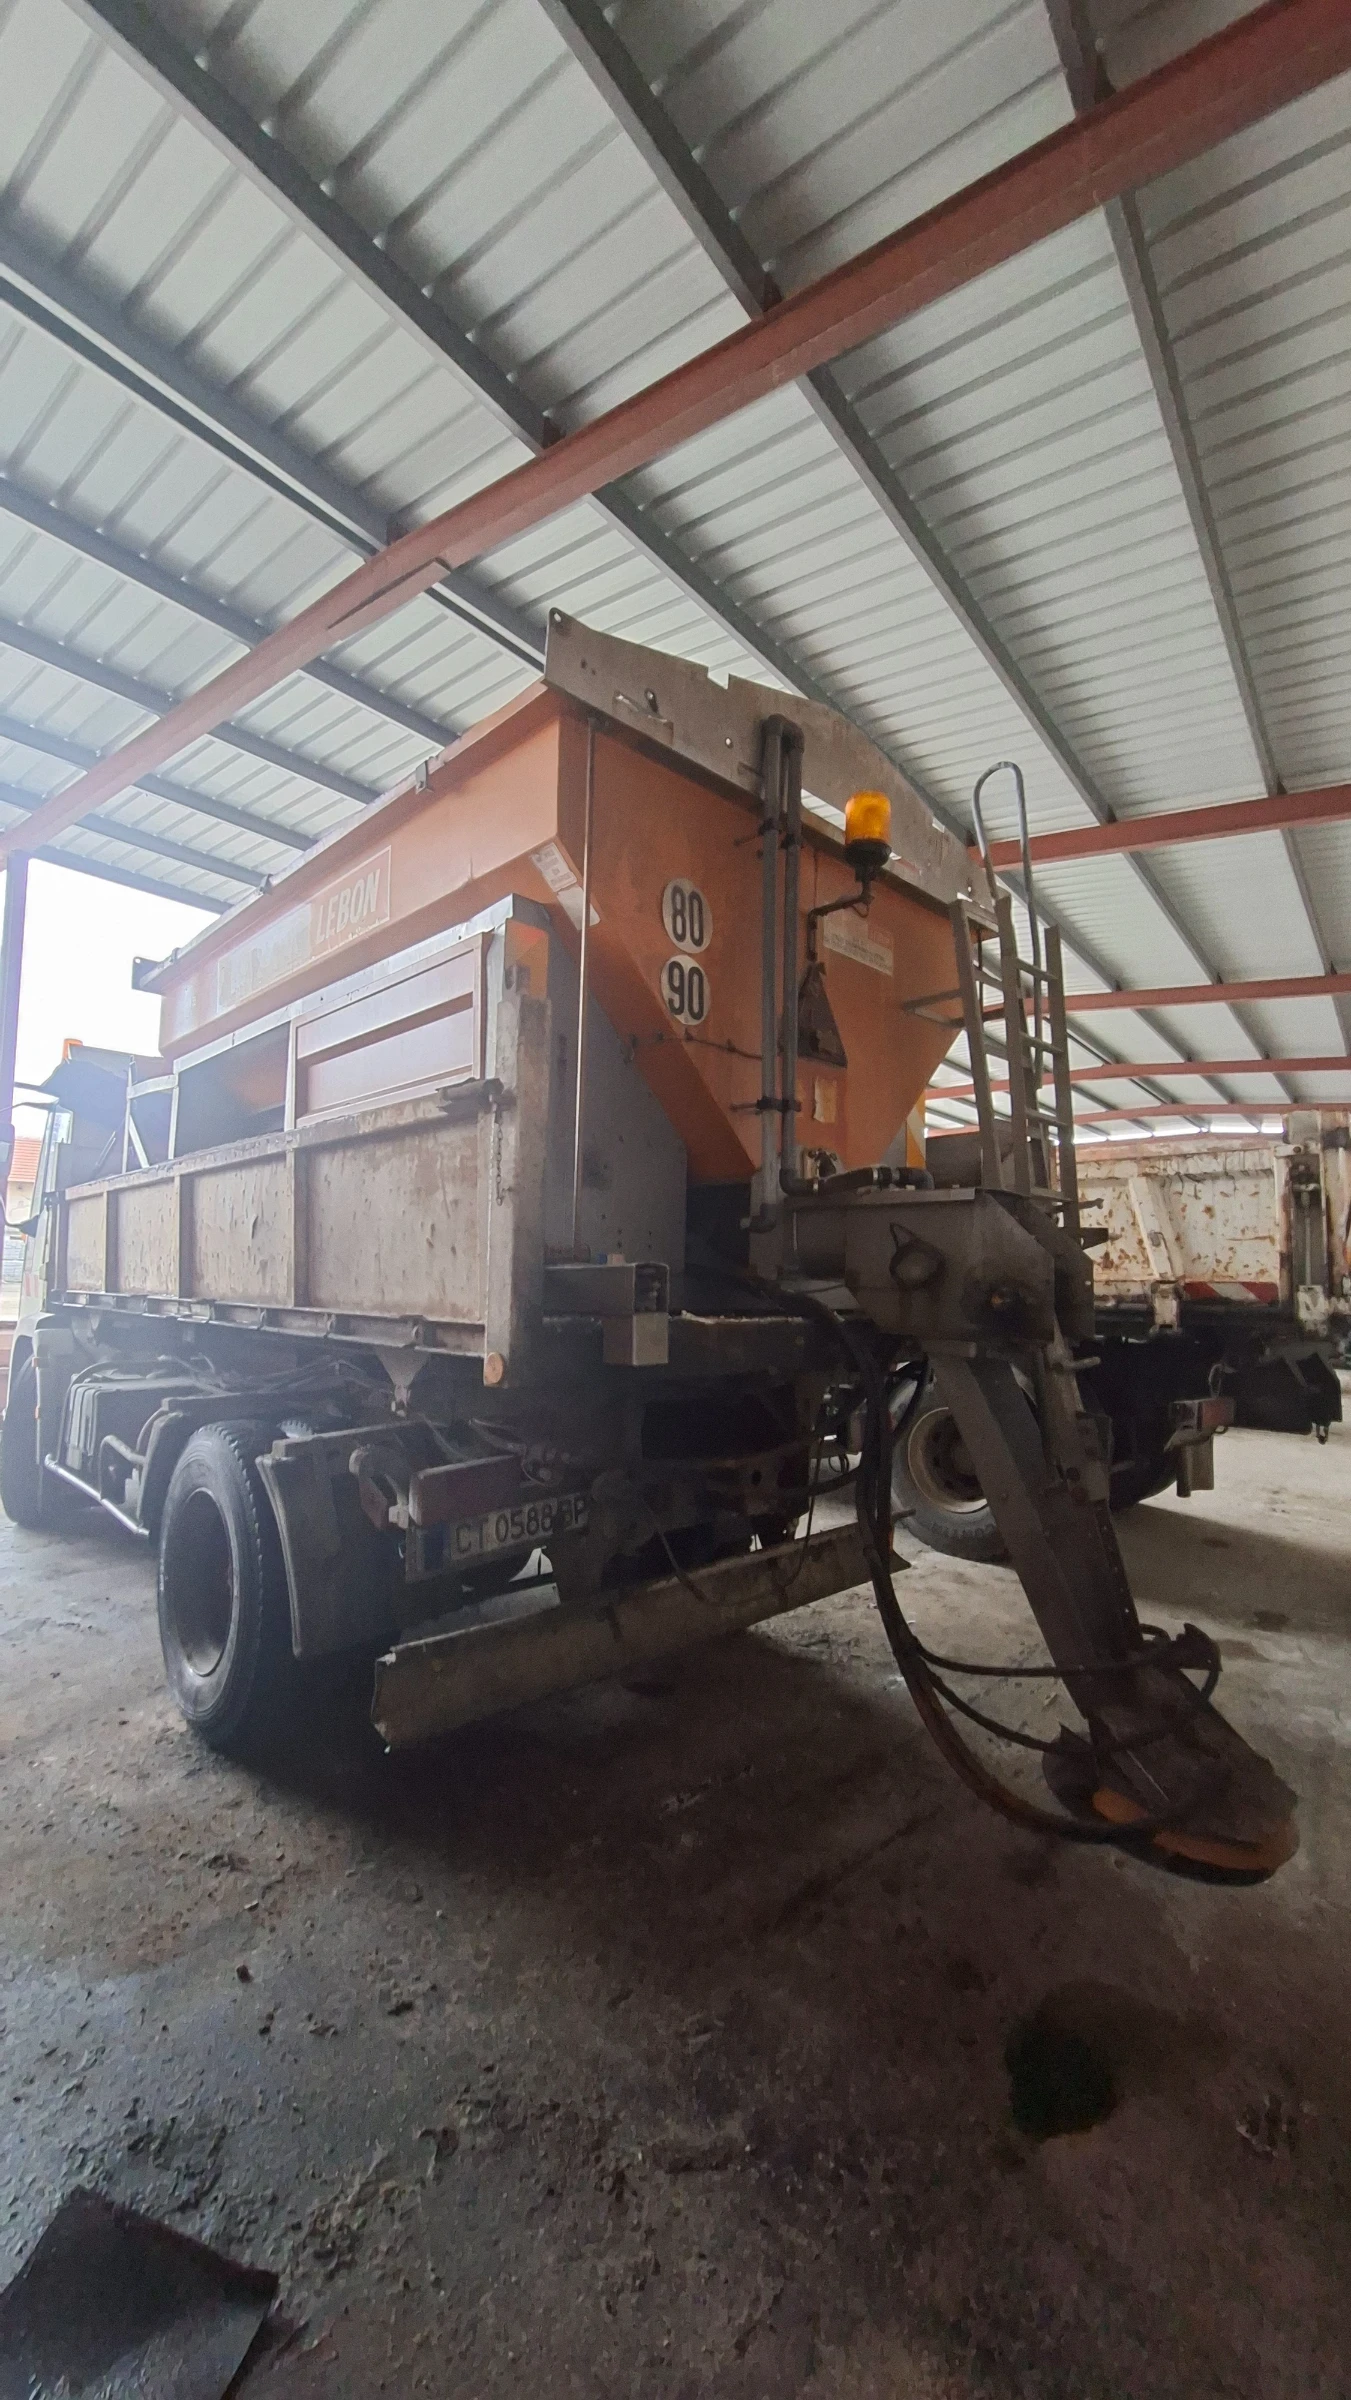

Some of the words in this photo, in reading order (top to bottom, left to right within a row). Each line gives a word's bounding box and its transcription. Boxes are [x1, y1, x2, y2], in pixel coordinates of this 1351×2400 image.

[317, 868, 382, 944] LEBON
[671, 886, 704, 947] 80
[668, 960, 704, 1021] 90
